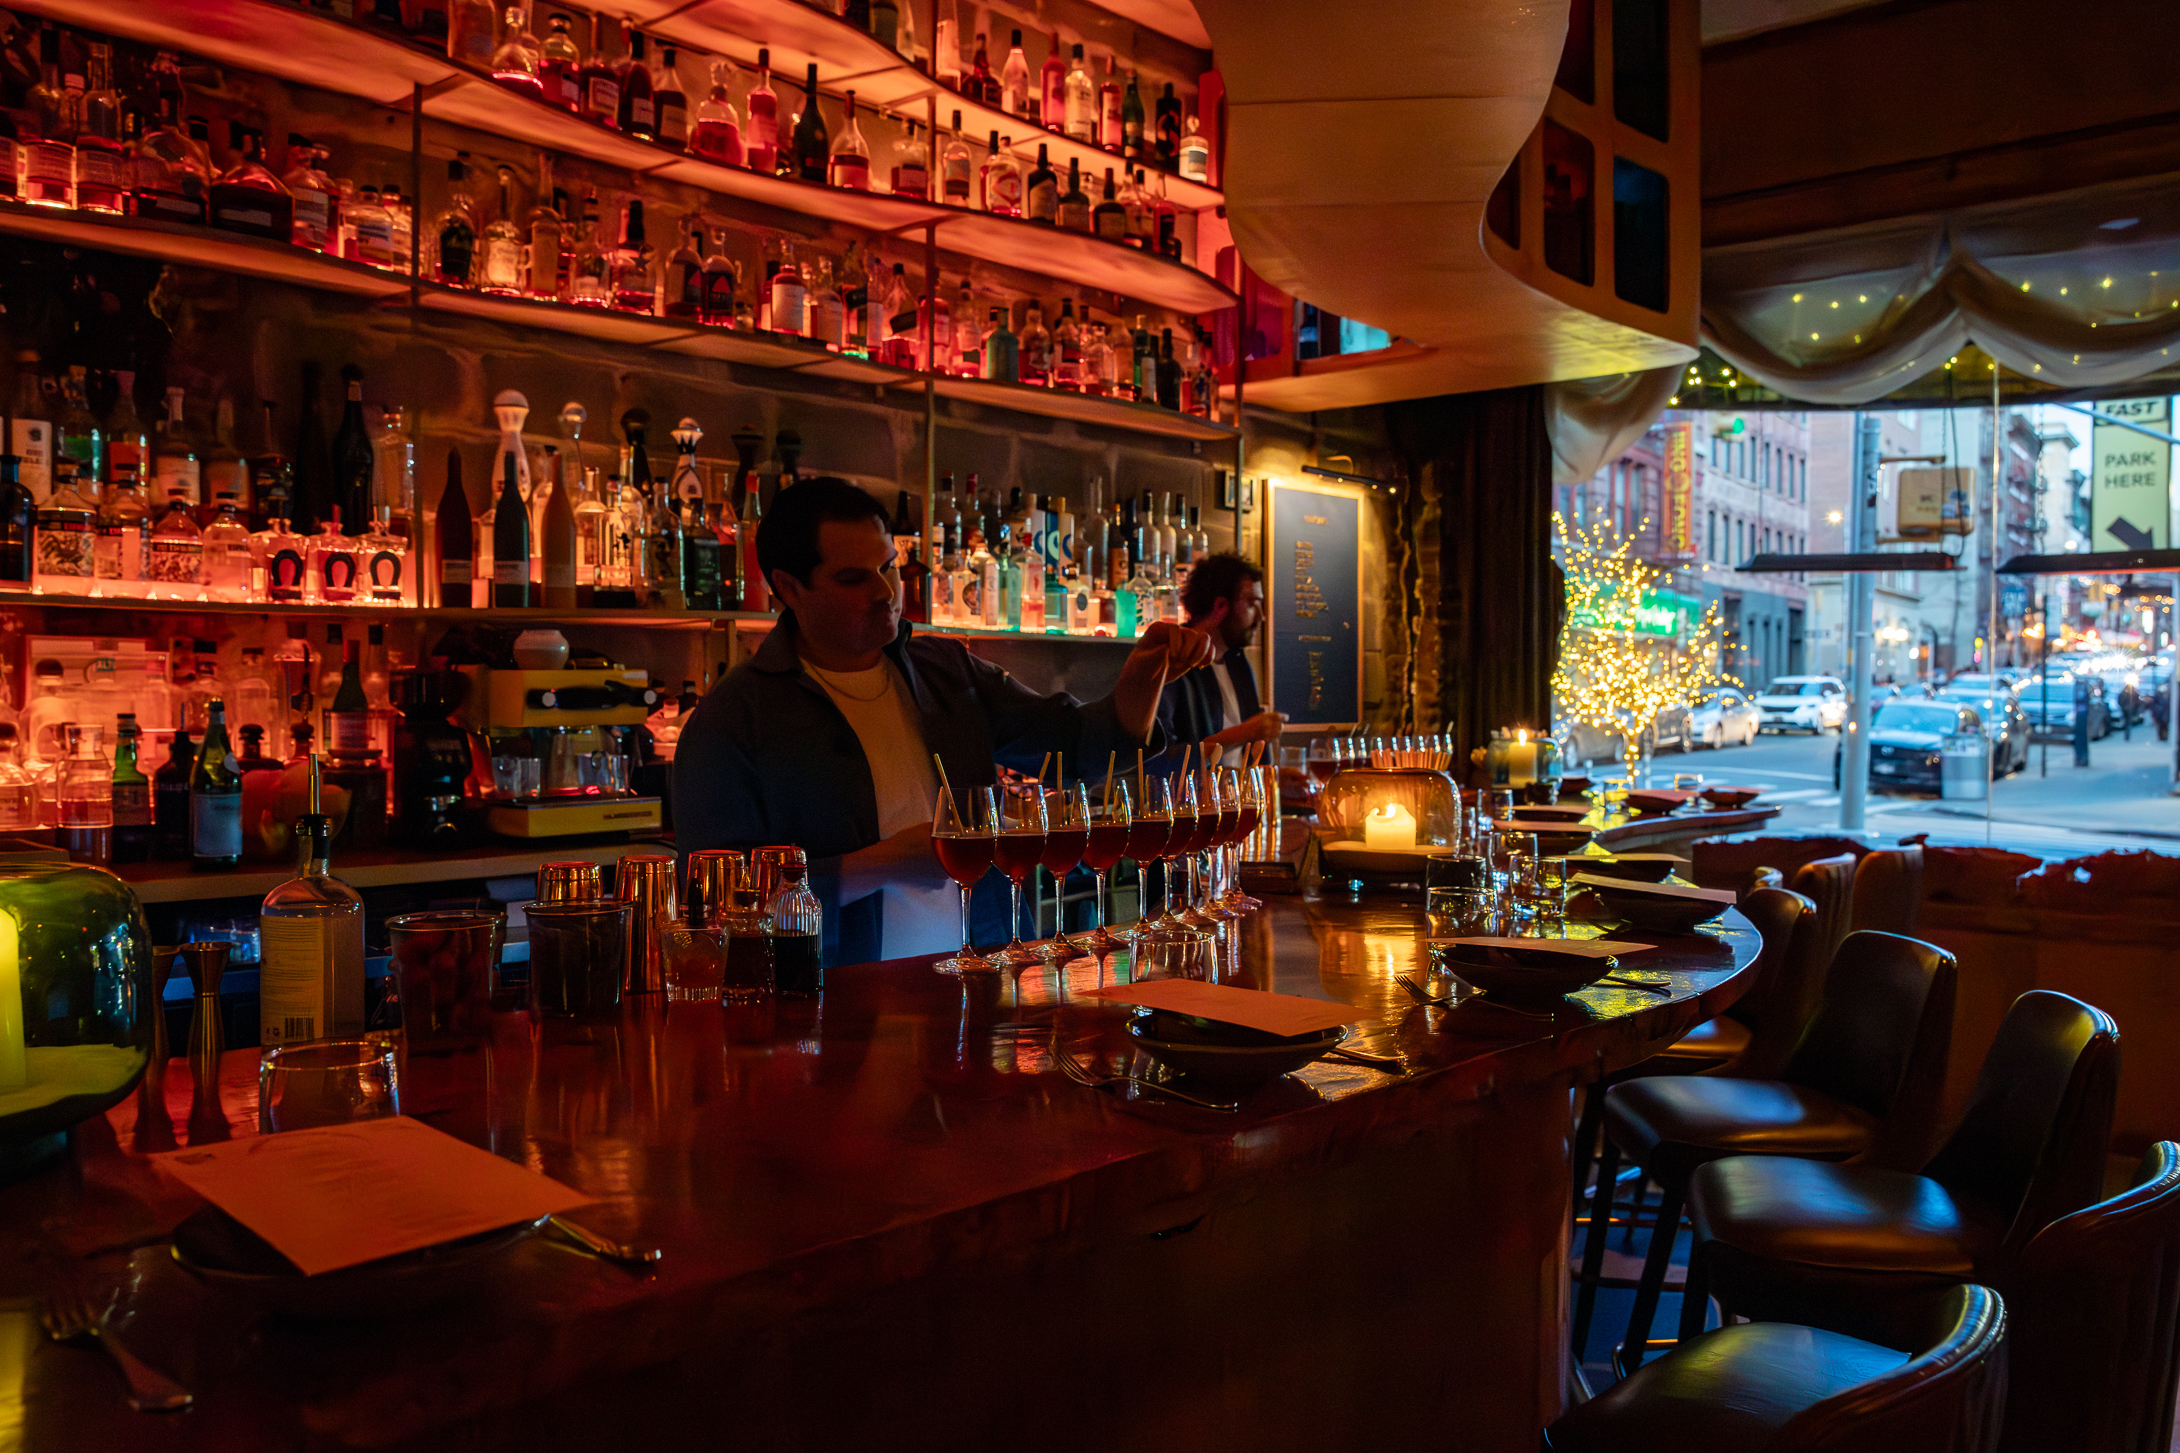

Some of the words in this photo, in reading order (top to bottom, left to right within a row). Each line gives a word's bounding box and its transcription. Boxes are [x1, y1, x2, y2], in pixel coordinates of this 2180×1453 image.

[2106, 401, 2158, 416] FAST
[2104, 450, 2156, 469] PARK
[2104, 471, 2156, 490] HERE
